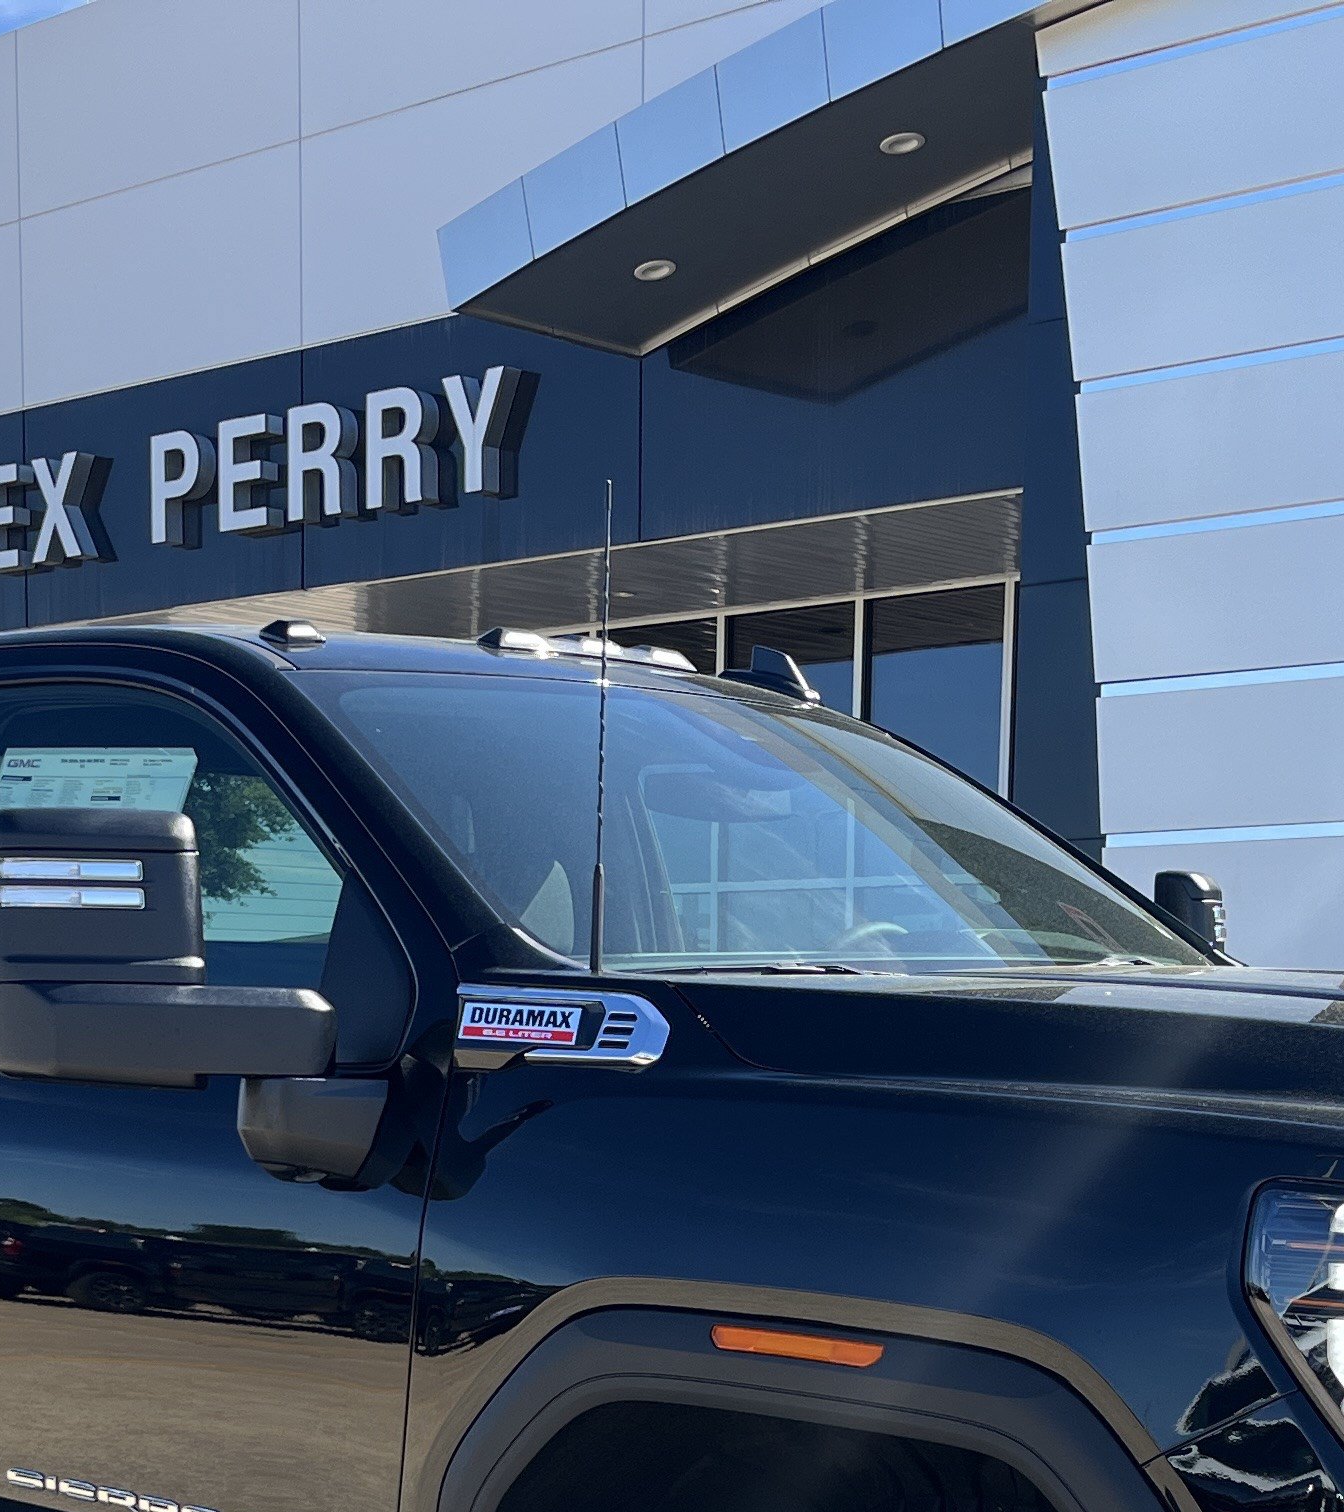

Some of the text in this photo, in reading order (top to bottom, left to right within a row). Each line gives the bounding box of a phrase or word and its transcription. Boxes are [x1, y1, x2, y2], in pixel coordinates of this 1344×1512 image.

[148, 364, 522, 550] PERRY
[6, 757, 42, 769] GMC
[470, 1006, 574, 1029] DURAMAX
[508, 1029, 554, 1039] LITER
